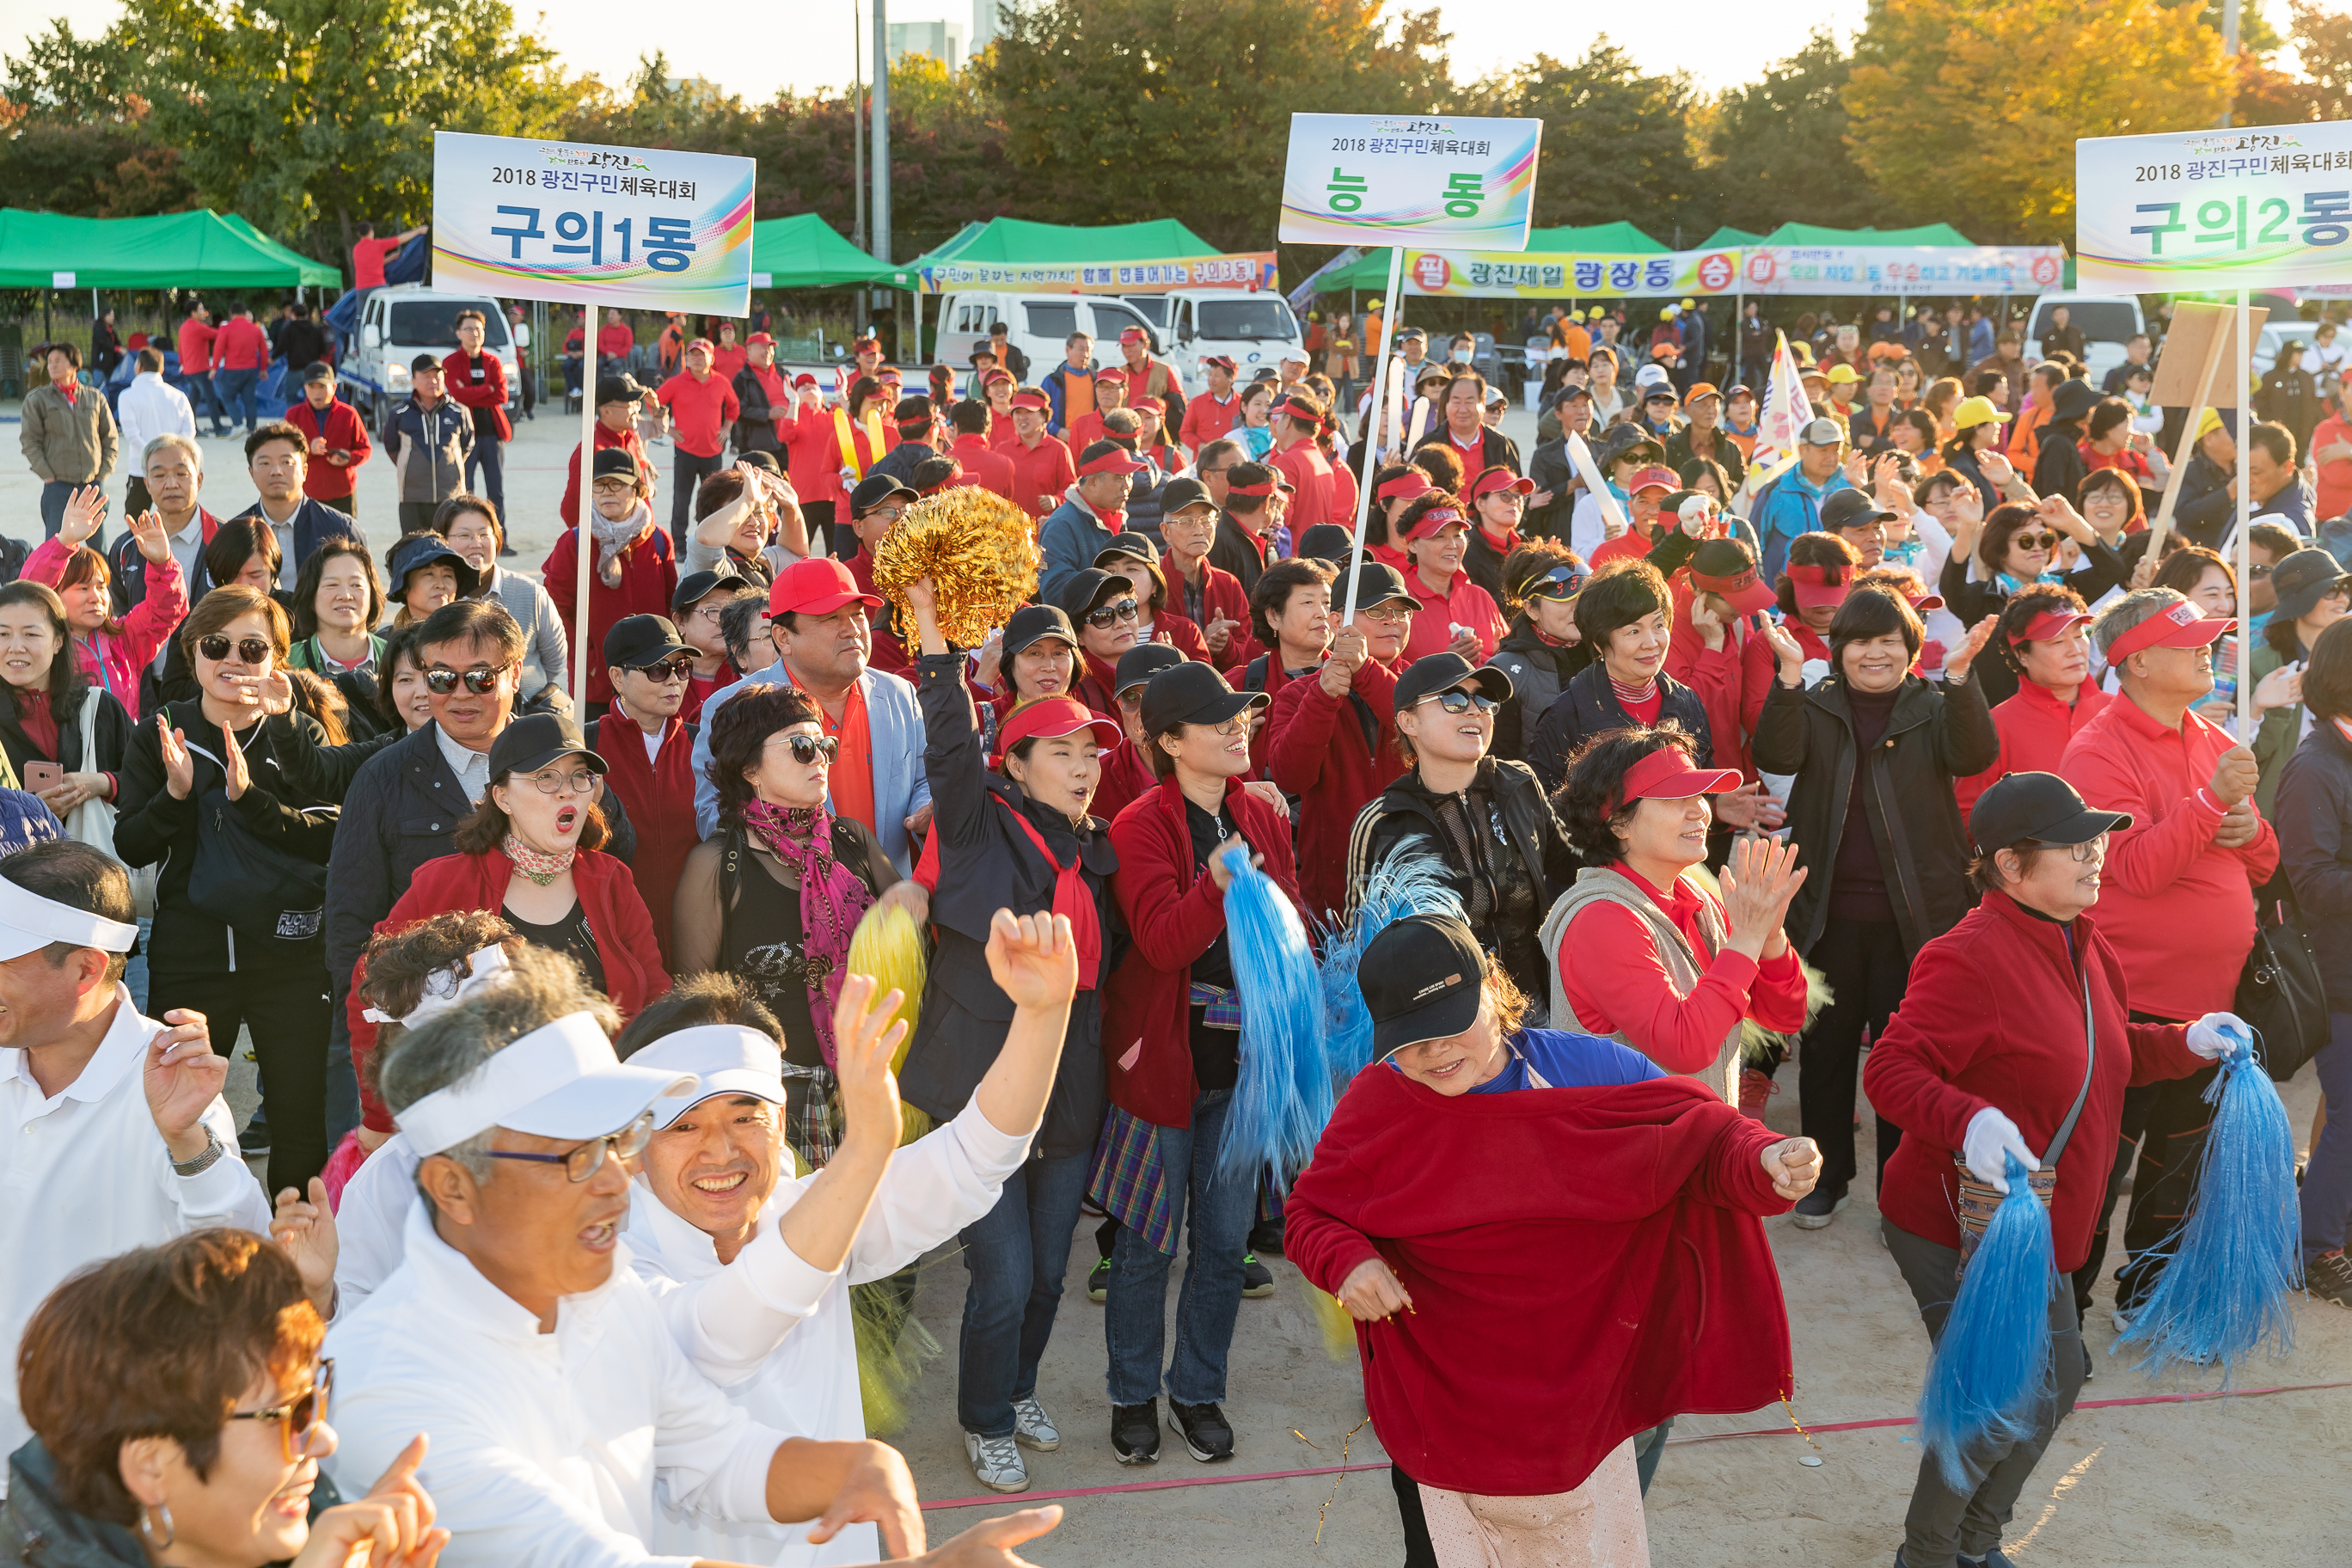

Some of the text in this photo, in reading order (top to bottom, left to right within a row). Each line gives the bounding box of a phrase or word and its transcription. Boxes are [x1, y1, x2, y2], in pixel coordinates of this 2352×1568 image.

[1332, 138, 1491, 156] 2018 광진구민체육대회
[2135, 150, 2352, 182] 2018 광진구민체육대회
[493, 167, 696, 201] 2018 광진구민체육대회
[1326, 167, 1485, 218] 능 동
[2130, 191, 2352, 254] 구의2동
[491, 205, 696, 273] 구의1동
[935, 266, 974, 284] 구민이
[978, 267, 1014, 284] 꿈꾸는
[1082, 267, 1112, 285] 함께
[1119, 264, 1187, 285] 만들어가는
[1418, 257, 1446, 287] 필
[1470, 259, 1672, 290] 광진제일 광장동
[1701, 254, 1730, 287] 승
[1753, 258, 1772, 279] 필
[2037, 258, 2055, 282] 승
